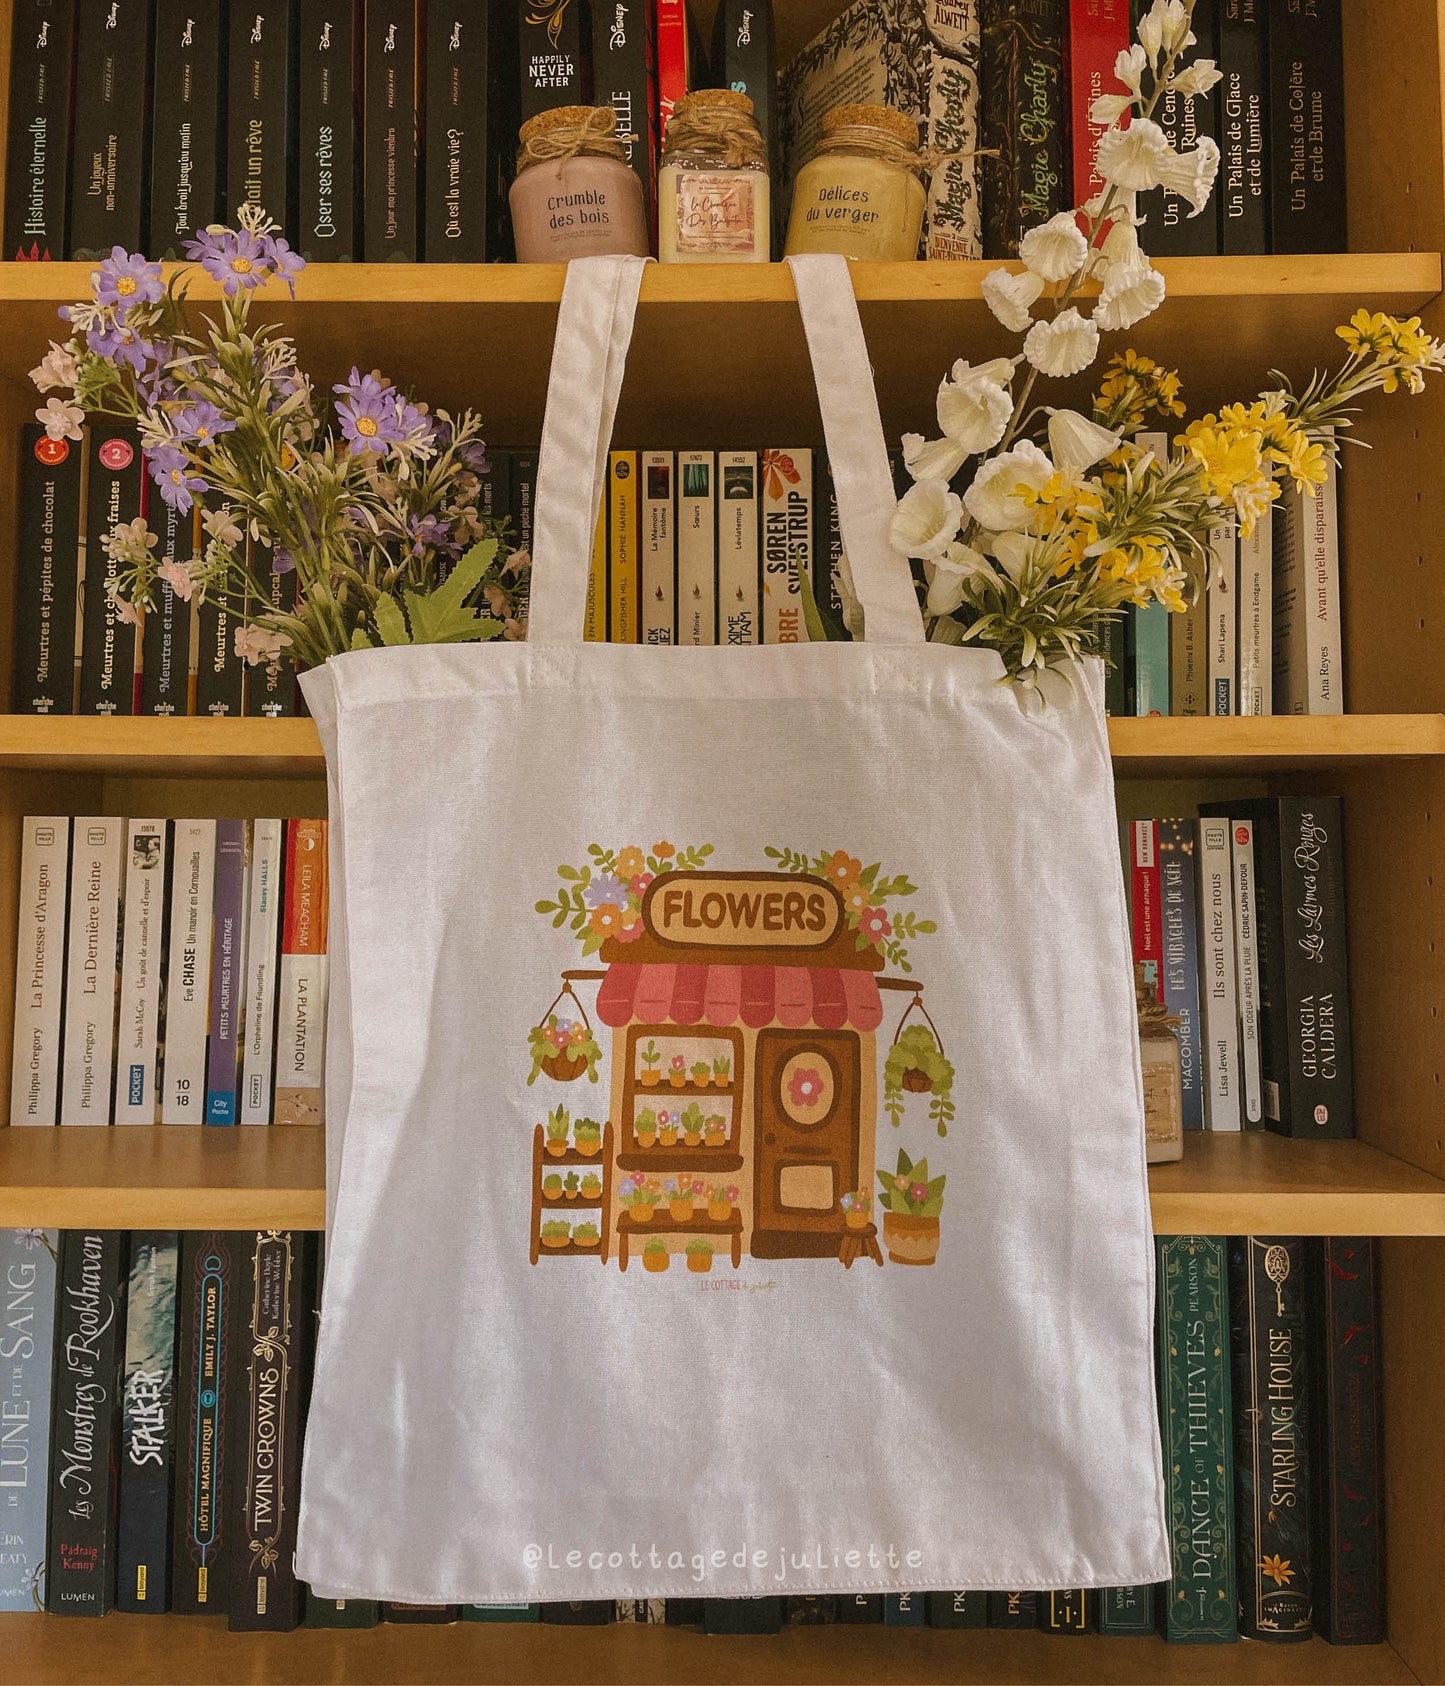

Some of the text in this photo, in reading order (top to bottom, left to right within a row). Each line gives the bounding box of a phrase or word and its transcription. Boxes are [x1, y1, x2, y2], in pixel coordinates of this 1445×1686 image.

[37, 21, 50, 48] Disney
[609, 3, 629, 50] Disney
[736, 9, 754, 48] Disney
[933, 5, 969, 32] ALWETT
[529, 63, 574, 77] NEVER
[531, 54, 570, 64] HAPPILY
[534, 77, 570, 88] AFTER
[1017, 58, 1058, 221] Magie Charly
[1181, 99, 1196, 150] Ruines
[1308, 91, 1323, 142] Brume
[245, 120, 263, 175] un rêve
[1226, 72, 1245, 218] Un Palais de Glace
[1246, 158, 1262, 177] de
[23, 117, 47, 236] Histoire éternelle
[86, 152, 105, 195] Un joyeux
[105, 134, 118, 211] non-anniversaire
[174, 123, 193, 235] Tout droit jusqu'au matin
[313, 126, 337, 237] Oser ses rêves
[445, 189, 460, 198] la
[447, 158, 460, 186] vraie
[819, 185, 869, 203] Délices
[1249, 178, 1262, 196] et
[445, 220, 462, 238] Où
[446, 202, 459, 217] est
[549, 208, 609, 229] des bois
[806, 207, 879, 224] du verger
[48, 443, 56, 454] 1
[111, 448, 121, 460] 2
[107, 480, 120, 523] fraises
[659, 507, 667, 539] fantôme
[619, 534, 627, 564] SOPHIE
[650, 507, 658, 552] La Mémoire
[736, 507, 744, 550] Léviatemps
[766, 512, 787, 574] SØREN
[36, 481, 55, 683] Meurtres et pépites de chocolat
[1252, 572, 1261, 606] Endgame
[1217, 613, 1227, 664] Shari Lapena
[1315, 547, 1331, 700] Ana Reyes Avant qu'elle
[101, 612, 115, 690] Meurtres et
[1252, 648, 1260, 669] Petits
[260, 859, 269, 913] Stacey HALLS
[299, 864, 312, 947] LEILA MEACHAM
[663, 890, 827, 931] FLOWERS
[1240, 863, 1250, 913] SAPIN-DEFOUR
[1294, 812, 1328, 964] Les Larmes Rouges
[83, 861, 101, 994] La Dernière Reine
[182, 851, 200, 1002] Eve CHASE Un manoir en Cornouailles
[27, 863, 51, 1115] Philippa Gregory La Princesse d'Aragon
[134, 878, 151, 1049] Sarah McCoy Un goût de cannelle d'espoir
[220, 918, 233, 1040] PETITS MEURTRES EN HÉRITAGE
[1211, 873, 1229, 1097] Lisa Jewell Ils sont chez nous
[253, 964, 265, 1056] L'Orpheline de Foundling
[294, 978, 308, 1072] LA PLANTATION
[1179, 1008, 1193, 1090] MACOMBER
[1300, 995, 1317, 1078] GEORGIA
[1319, 993, 1337, 1079] CALDERA
[176, 1079, 190, 1090] 10
[176, 1095, 190, 1106] 18
[1188, 1258, 1199, 1312] PEARSON
[0, 1263, 36, 1487] LUNE SANG
[59, 1235, 114, 1520] Les Monstres de Rookhaven
[128, 1369, 164, 1467] STALKER
[199, 1287, 217, 1532] HÔTEL MAGNIFIQUE EMILY J. TAYLOR
[1268, 1328, 1299, 1508] STARLING HOUSE
[254, 1367, 279, 1532] TWIN CROWNS
[1186, 1320, 1217, 1579] DANCE OF THIEVES
[63, 1558, 95, 1573] Kenny
[61, 1593, 95, 1602] LUMEN
